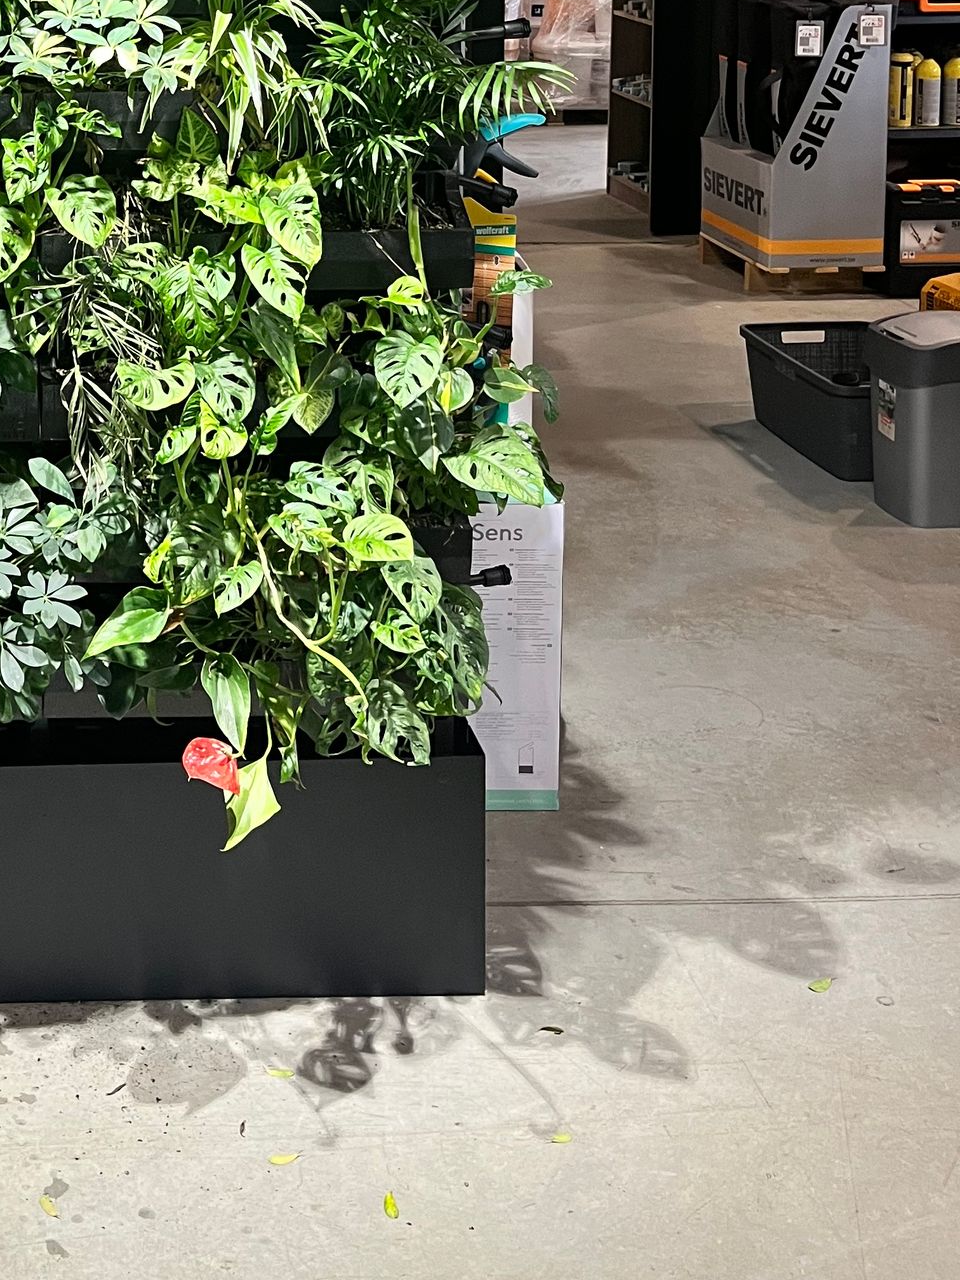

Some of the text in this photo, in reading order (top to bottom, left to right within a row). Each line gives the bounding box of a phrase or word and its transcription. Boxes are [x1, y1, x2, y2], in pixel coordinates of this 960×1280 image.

[790, 22, 867, 171] SIEVERT
[703, 166, 766, 217] SIEVERT
[475, 226, 510, 236] wolfcraft
